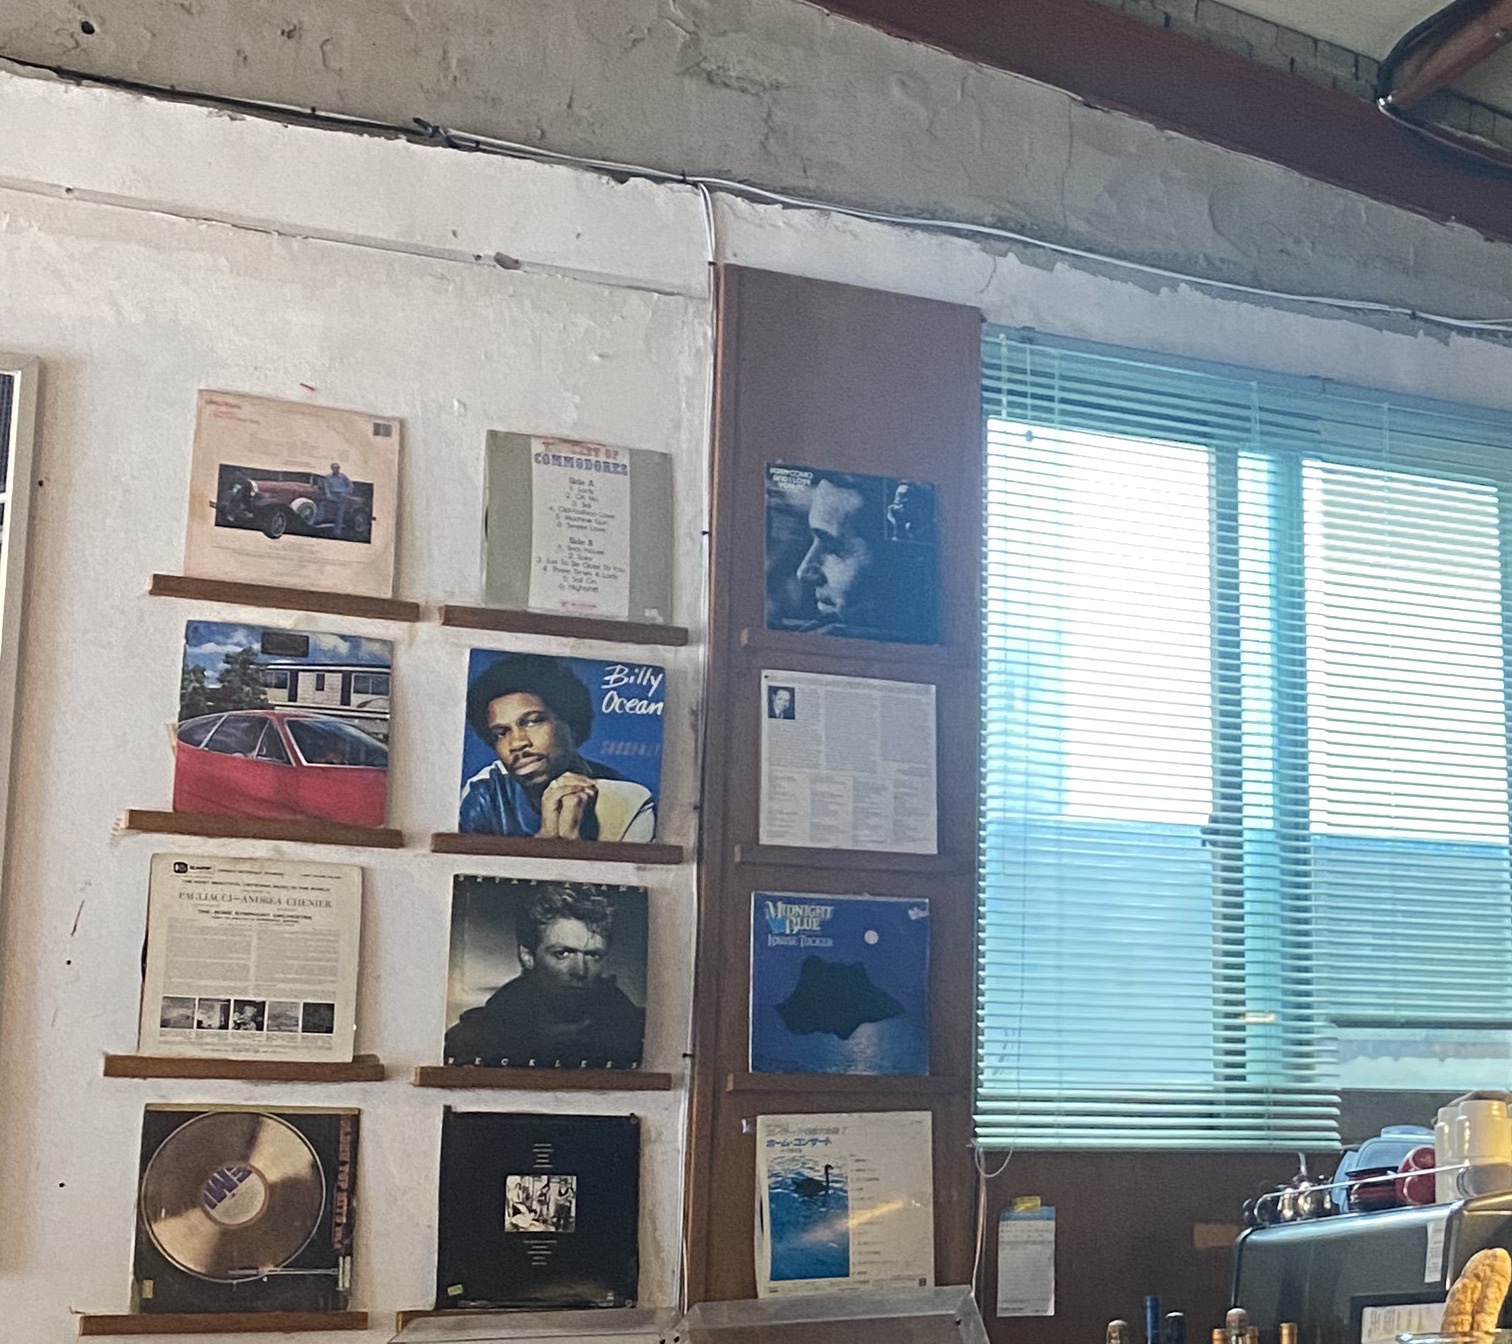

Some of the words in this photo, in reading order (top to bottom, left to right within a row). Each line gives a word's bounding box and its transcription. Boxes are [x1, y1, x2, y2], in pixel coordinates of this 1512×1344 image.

[601, 664, 663, 697] Billy
[602, 690, 664, 715] Ocean
[765, 901, 834, 920] MIDNIGHT
